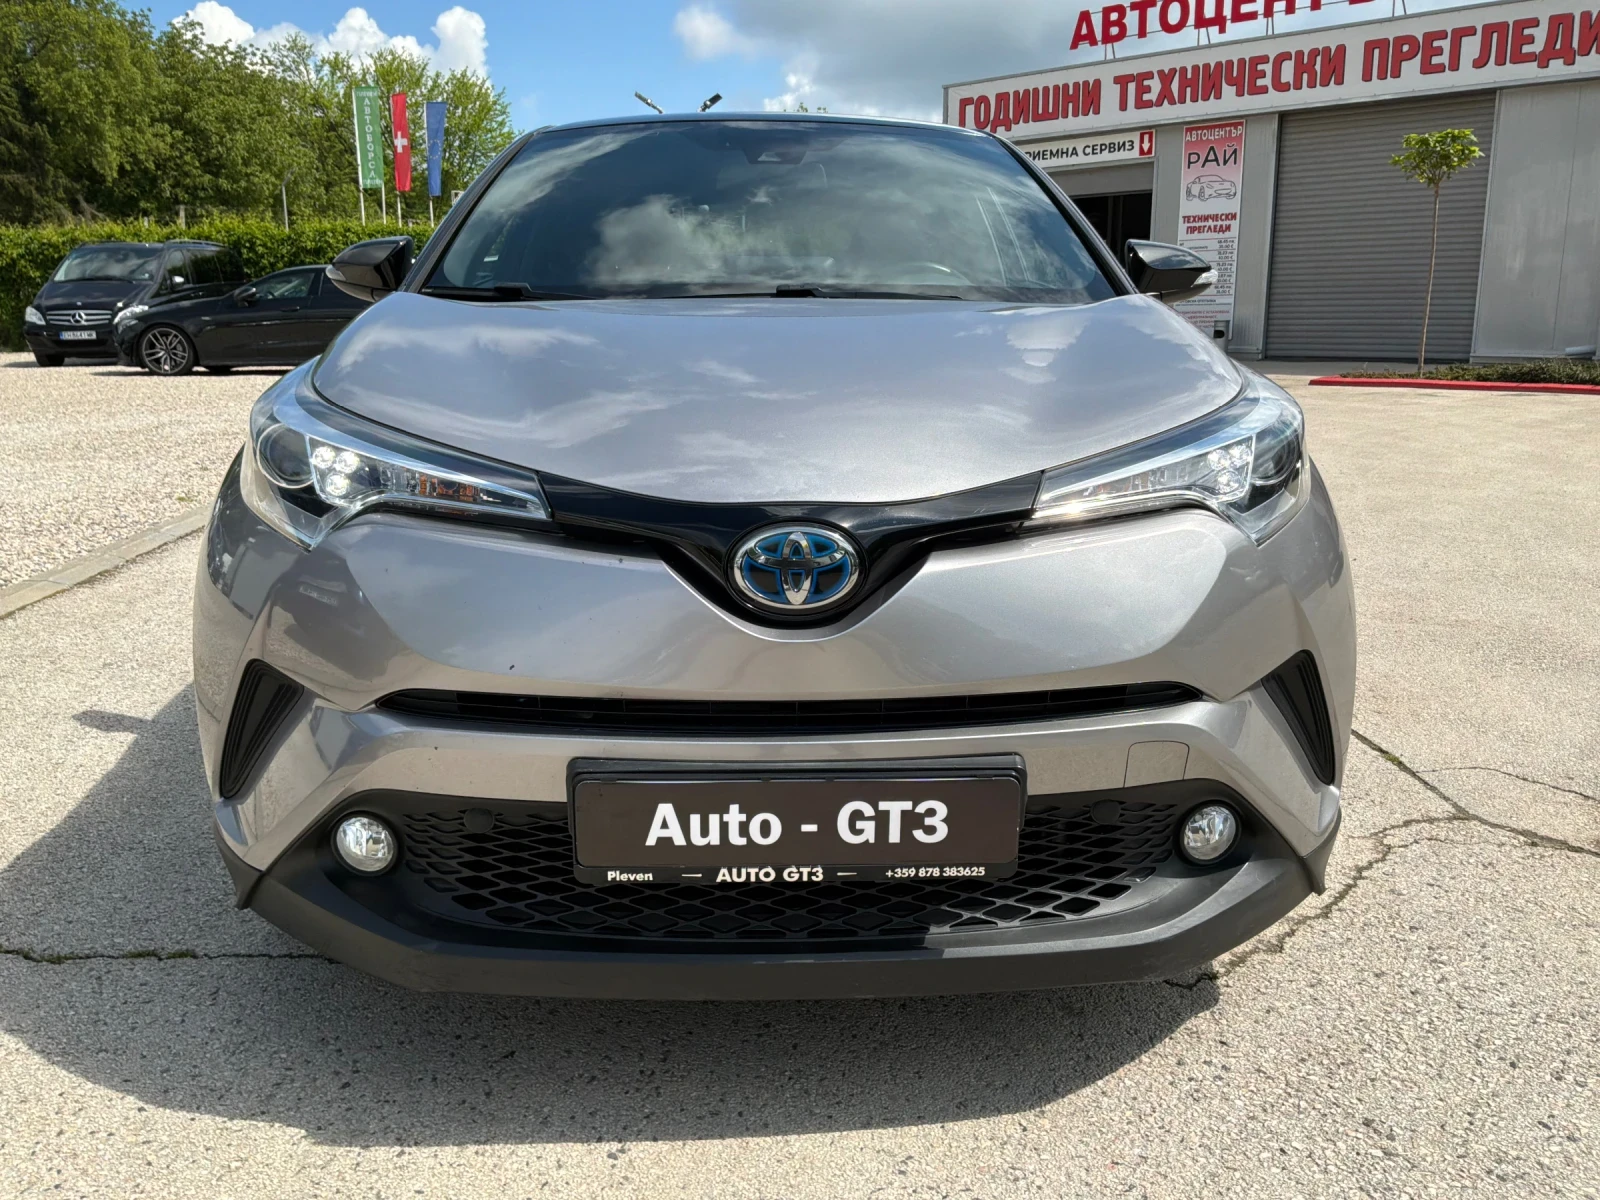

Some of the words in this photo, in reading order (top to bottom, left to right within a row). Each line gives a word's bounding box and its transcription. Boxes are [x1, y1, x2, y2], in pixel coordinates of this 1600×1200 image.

[958, 78, 1102, 134] ГОДИШНИ
[1113, 43, 1347, 112] ТЕХНИЧЕСКИ
[1361, 9, 1600, 83] ПРЕГЛЕДИ
[364, 97, 376, 178] АВТОБОРСА
[1185, 125, 1243, 142] АВТОЦЕНТЪР
[1082, 139, 1135, 156] СЕРВИЗ
[1187, 143, 1238, 170] РАЙ
[1182, 212, 1238, 225] ТЕХНИЧЕСКИ
[1185, 224, 1232, 235] ПРЕГЛЕДИ
[645, 802, 783, 846] Auto
[836, 800, 949, 845] GT3
[607, 870, 654, 882] Pleven
[715, 866, 777, 883] AUTO
[782, 866, 824, 882] GT3
[885, 866, 915, 878] +359
[918, 866, 940, 877] 878
[942, 866, 986, 877] 383625
